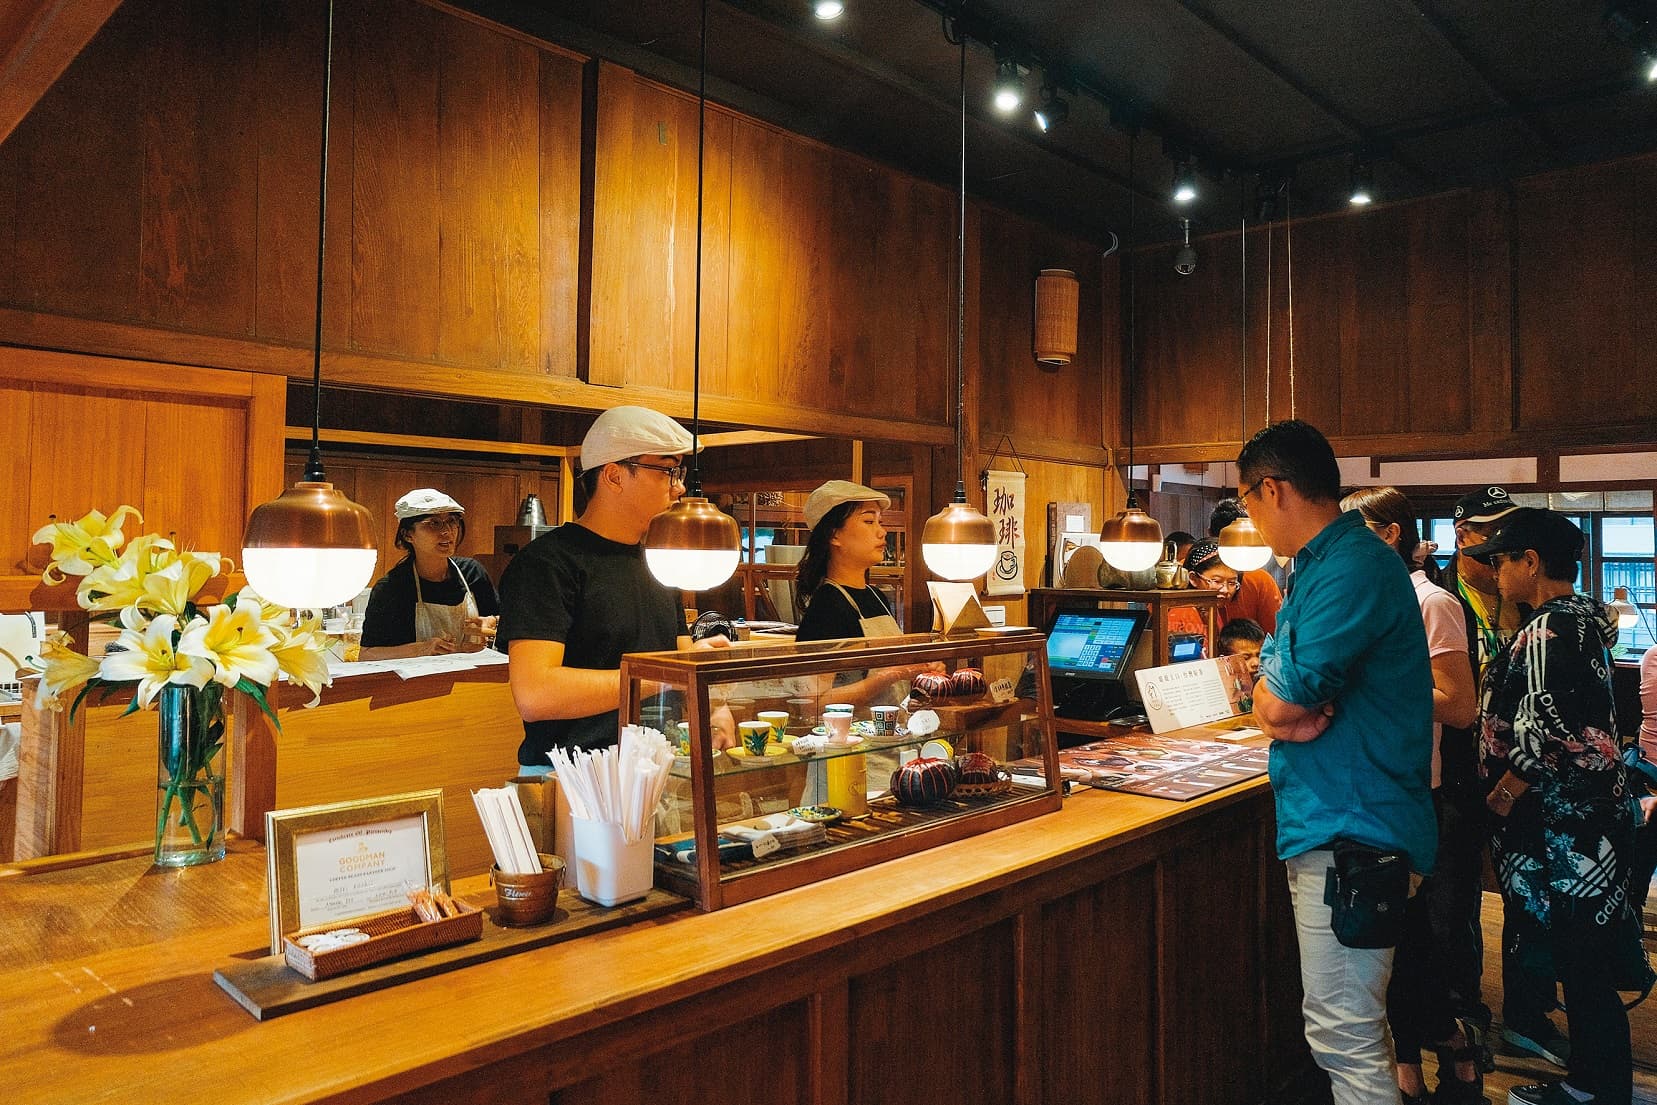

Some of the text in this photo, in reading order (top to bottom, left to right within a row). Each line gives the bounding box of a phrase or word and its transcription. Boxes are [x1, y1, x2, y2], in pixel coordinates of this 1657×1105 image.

[993, 486, 1020, 549] 珈琲
[338, 850, 385, 865] GOODMAN
[339, 860, 385, 873] COMPANY
[1595, 867, 1632, 926] adida
